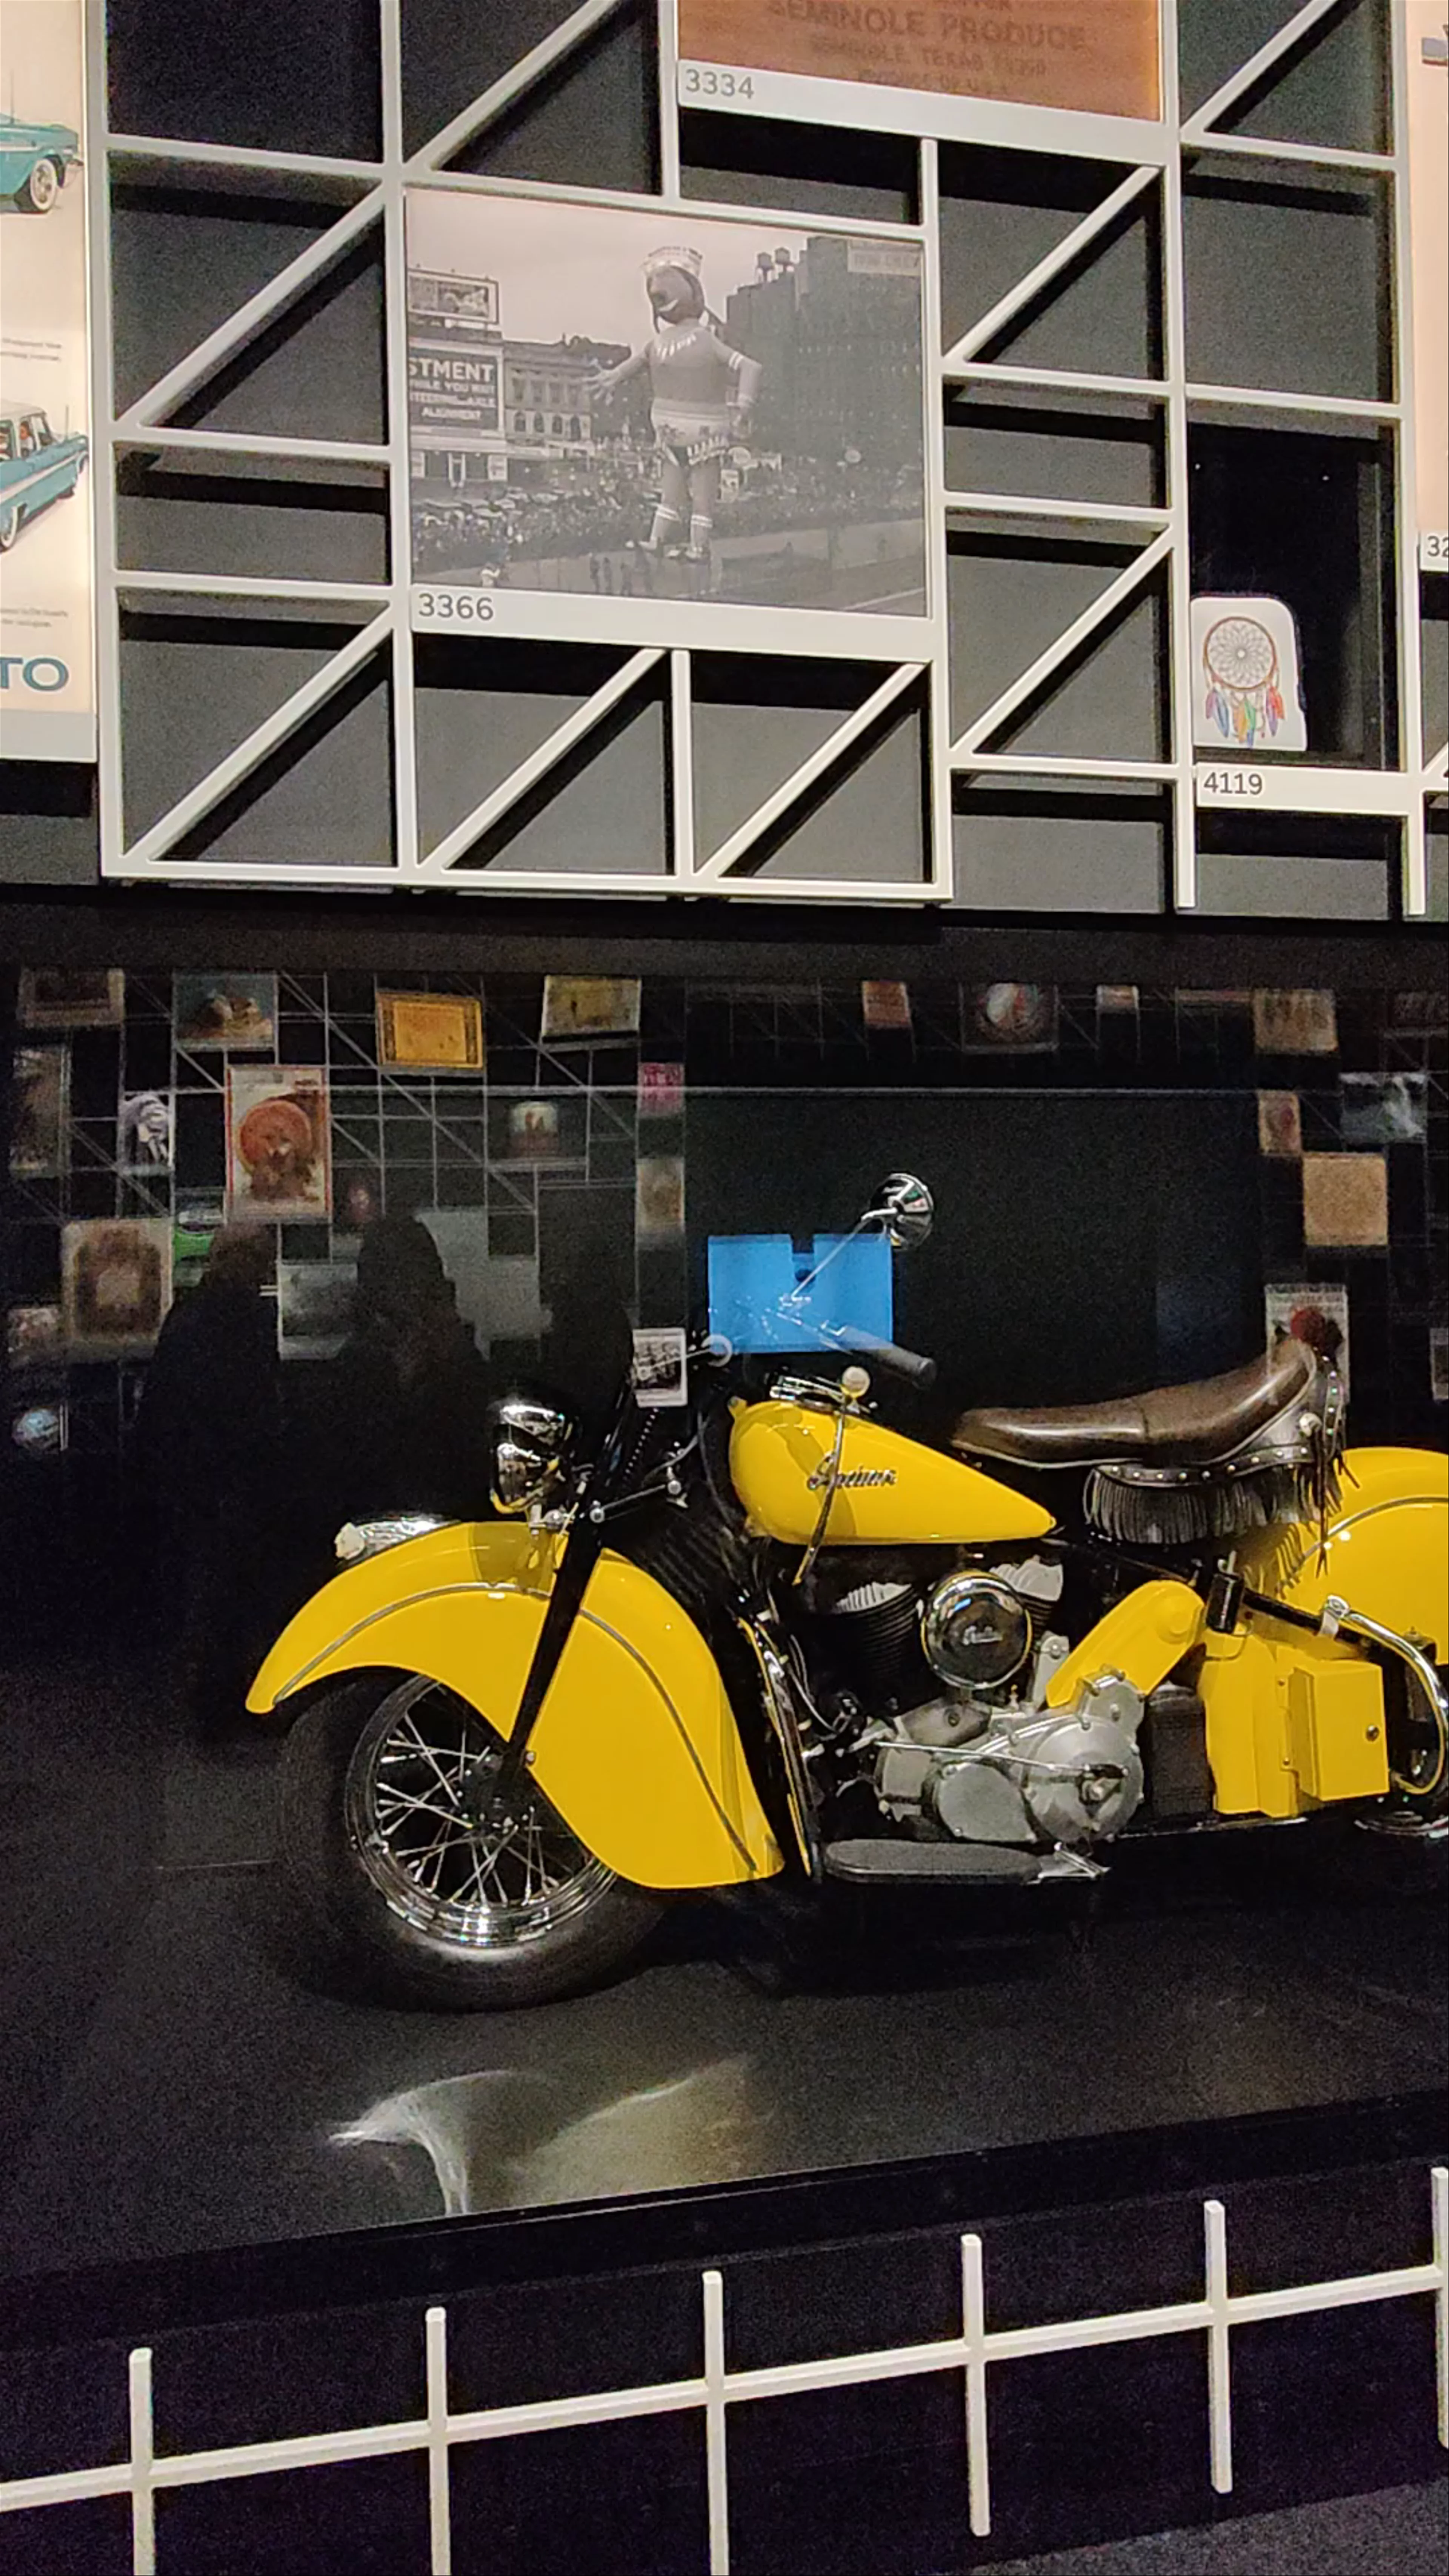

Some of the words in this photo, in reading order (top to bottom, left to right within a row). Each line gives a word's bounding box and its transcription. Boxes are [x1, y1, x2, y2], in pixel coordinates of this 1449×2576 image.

[941, 13, 1085, 50] PRODUCE
[685, 69, 754, 99] 3334
[418, 592, 494, 621] 3366
[1203, 772, 1263, 795] 4119
